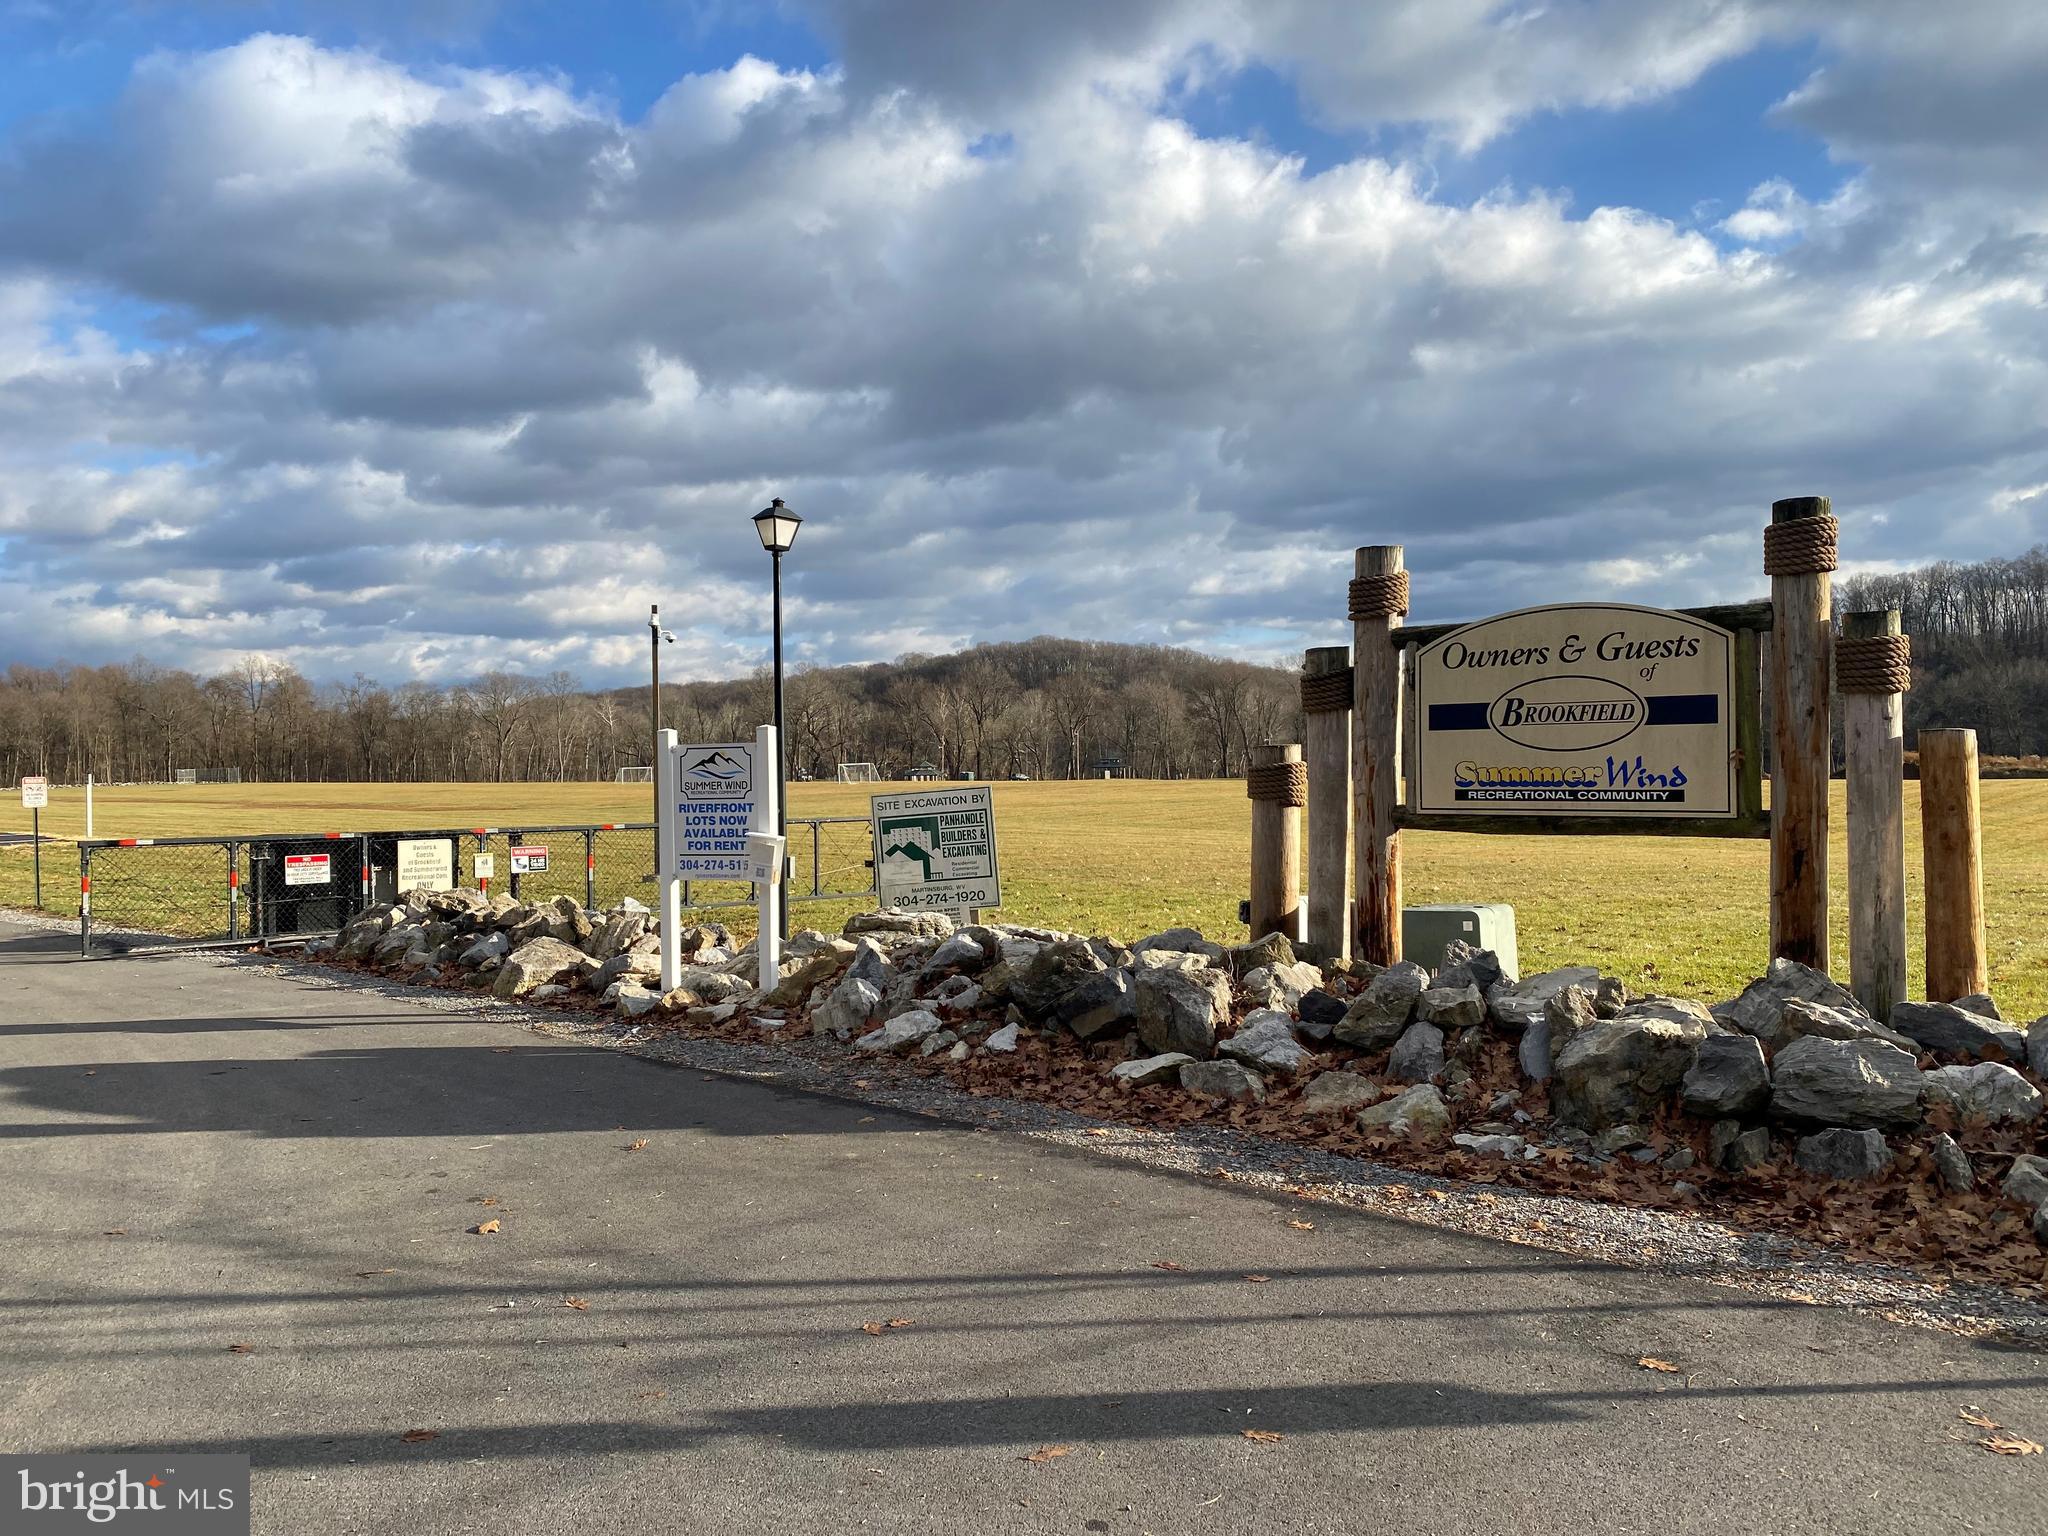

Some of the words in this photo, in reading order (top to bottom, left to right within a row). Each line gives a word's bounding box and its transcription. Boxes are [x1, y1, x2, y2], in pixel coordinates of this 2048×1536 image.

[1442, 642, 1550, 669] Owners
[1558, 634, 1587, 663] &
[1596, 631, 1700, 662] Guests
[1639, 663, 1659, 682] of
[1499, 697, 1636, 727] BROOKFIELD
[1454, 760, 1604, 788] Summer
[1606, 755, 1688, 789] Wind
[684, 781, 723, 791] SUMMER
[724, 780, 748, 790] WIND
[877, 800, 900, 811] SITE
[904, 795, 967, 809] EXCAVATION
[971, 794, 986, 804] BY
[1467, 790, 1574, 801] RECREATIONAL
[1577, 790, 1669, 801] COMMUNITY
[678, 802, 755, 813] RIVERFRONT
[685, 815, 716, 826] LOTS
[719, 815, 748, 826] NOW
[940, 812, 984, 826] PANHANDLE
[684, 828, 750, 838] AVAILABLE
[940, 829, 977, 843] BUILDERS
[980, 828, 986, 840] &
[687, 840, 711, 851] FOR
[714, 840, 747, 851] RENT
[942, 844, 987, 858] EXCAVATING
[416, 881, 434, 889] ONLY
[911, 885, 954, 894] MARTINSBURG,
[893, 890, 986, 907] 304-274-1920
